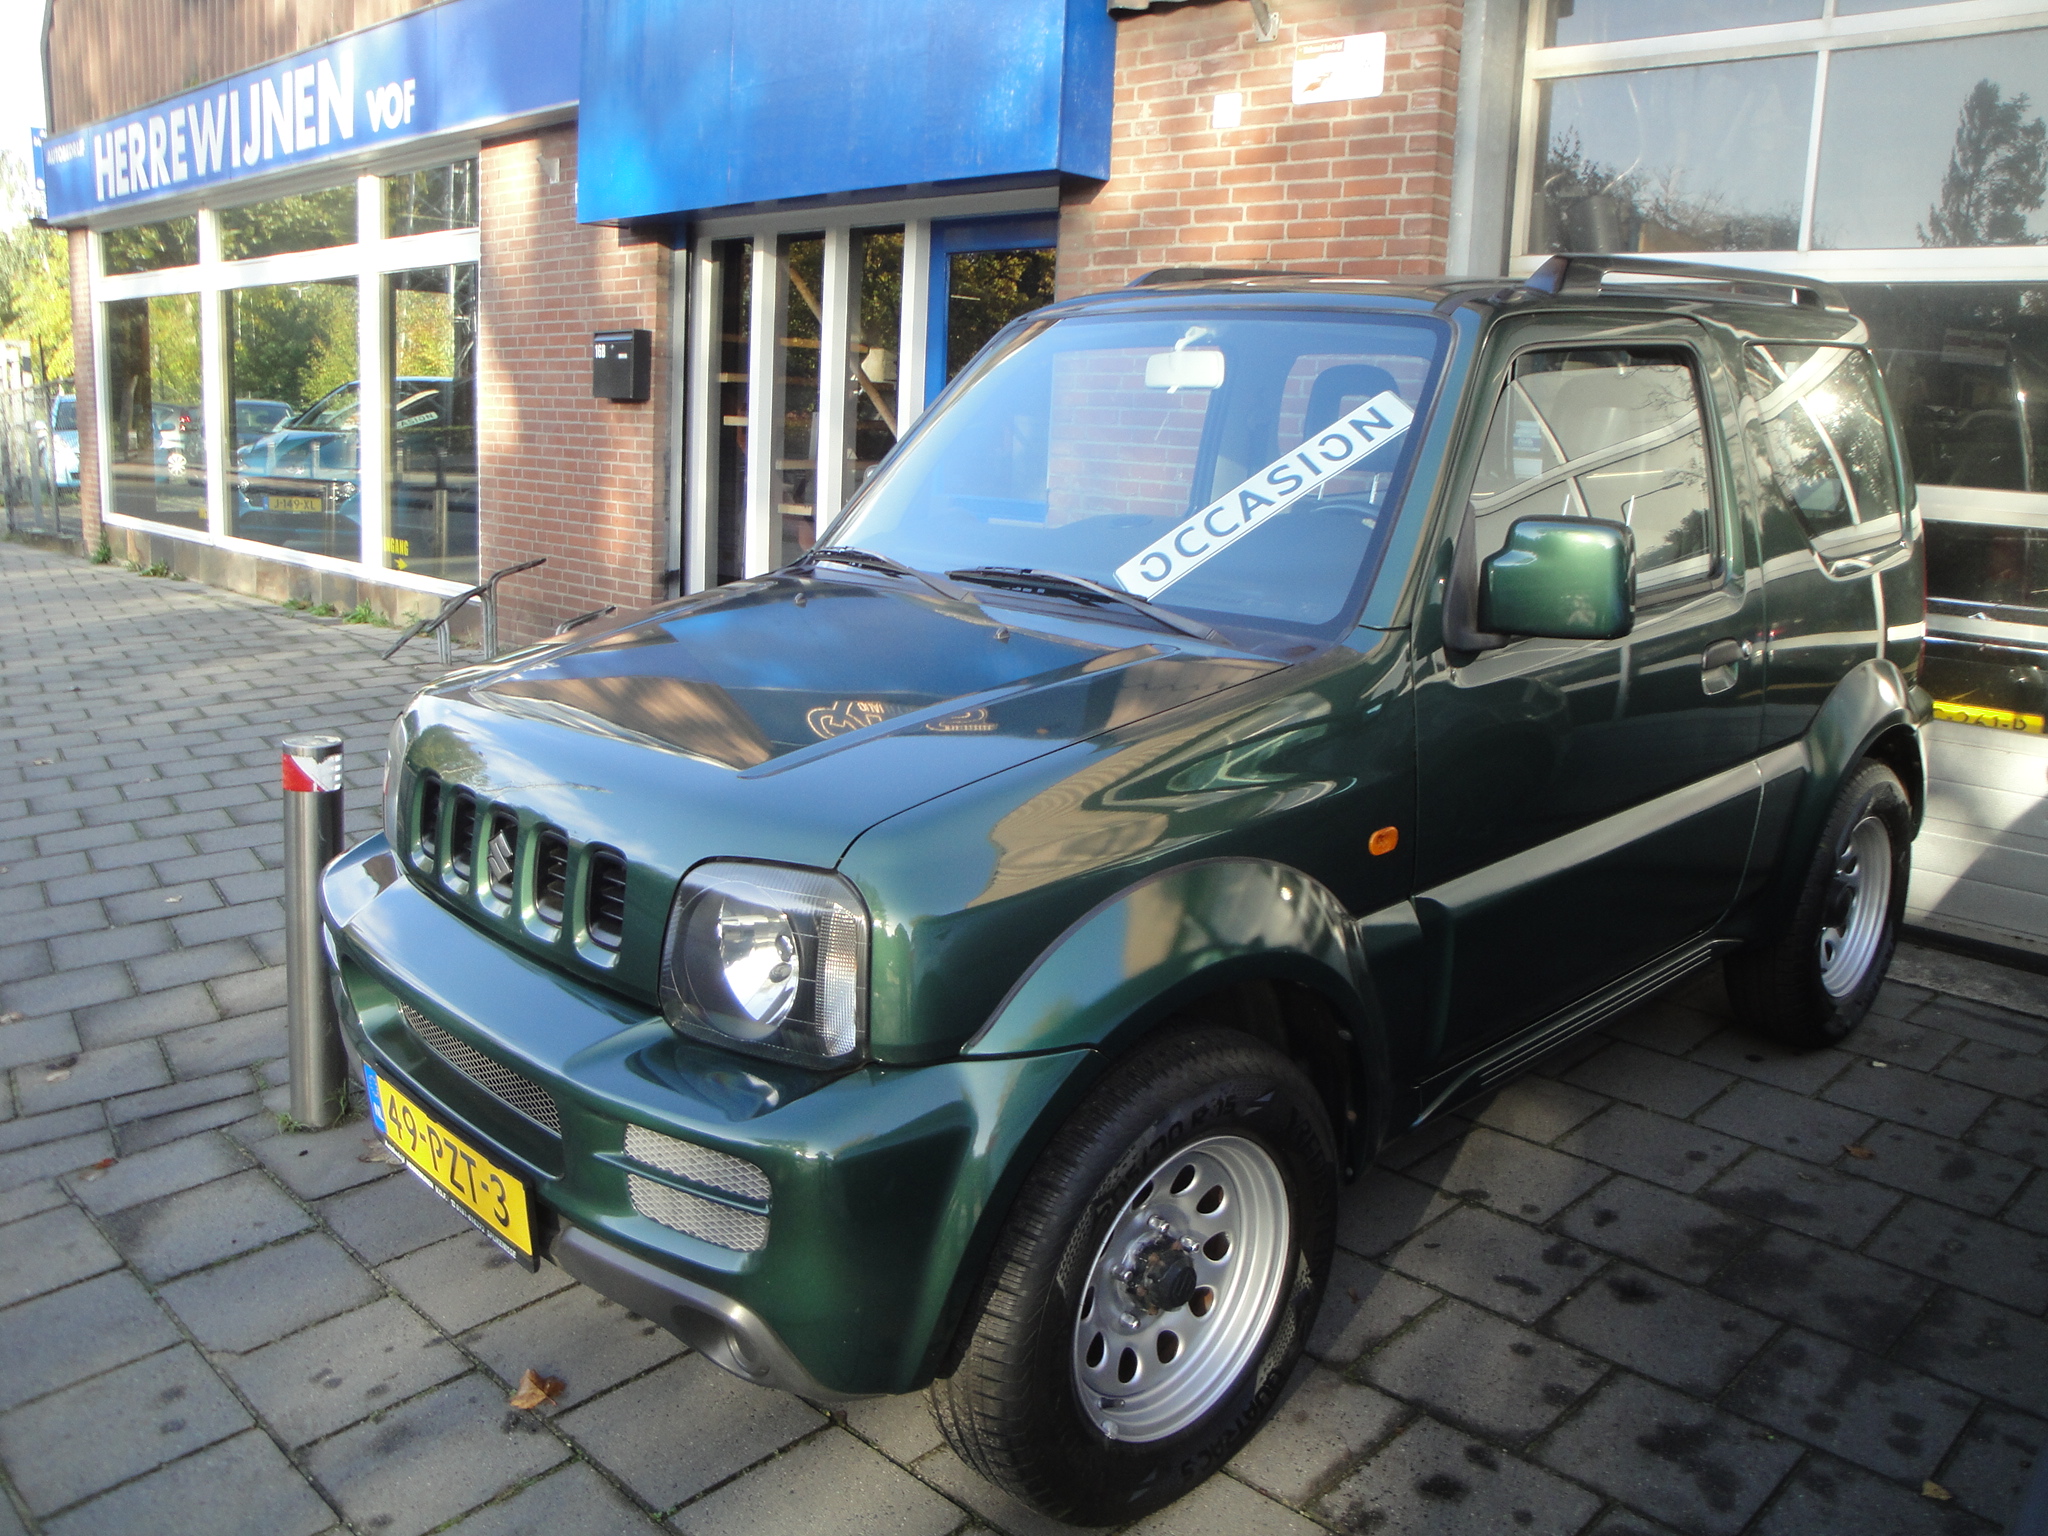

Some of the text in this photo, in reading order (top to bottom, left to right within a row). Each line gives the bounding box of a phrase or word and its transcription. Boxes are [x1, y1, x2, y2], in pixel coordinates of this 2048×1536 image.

[94, 52, 354, 200] HERREWIJNEN
[366, 79, 416, 132] VOF
[274, 499, 316, 511] J-149-XL
[1139, 406, 1395, 584] OCCASION
[373, 1102, 385, 1122] NL
[388, 1094, 510, 1228] 49-PZT-3
